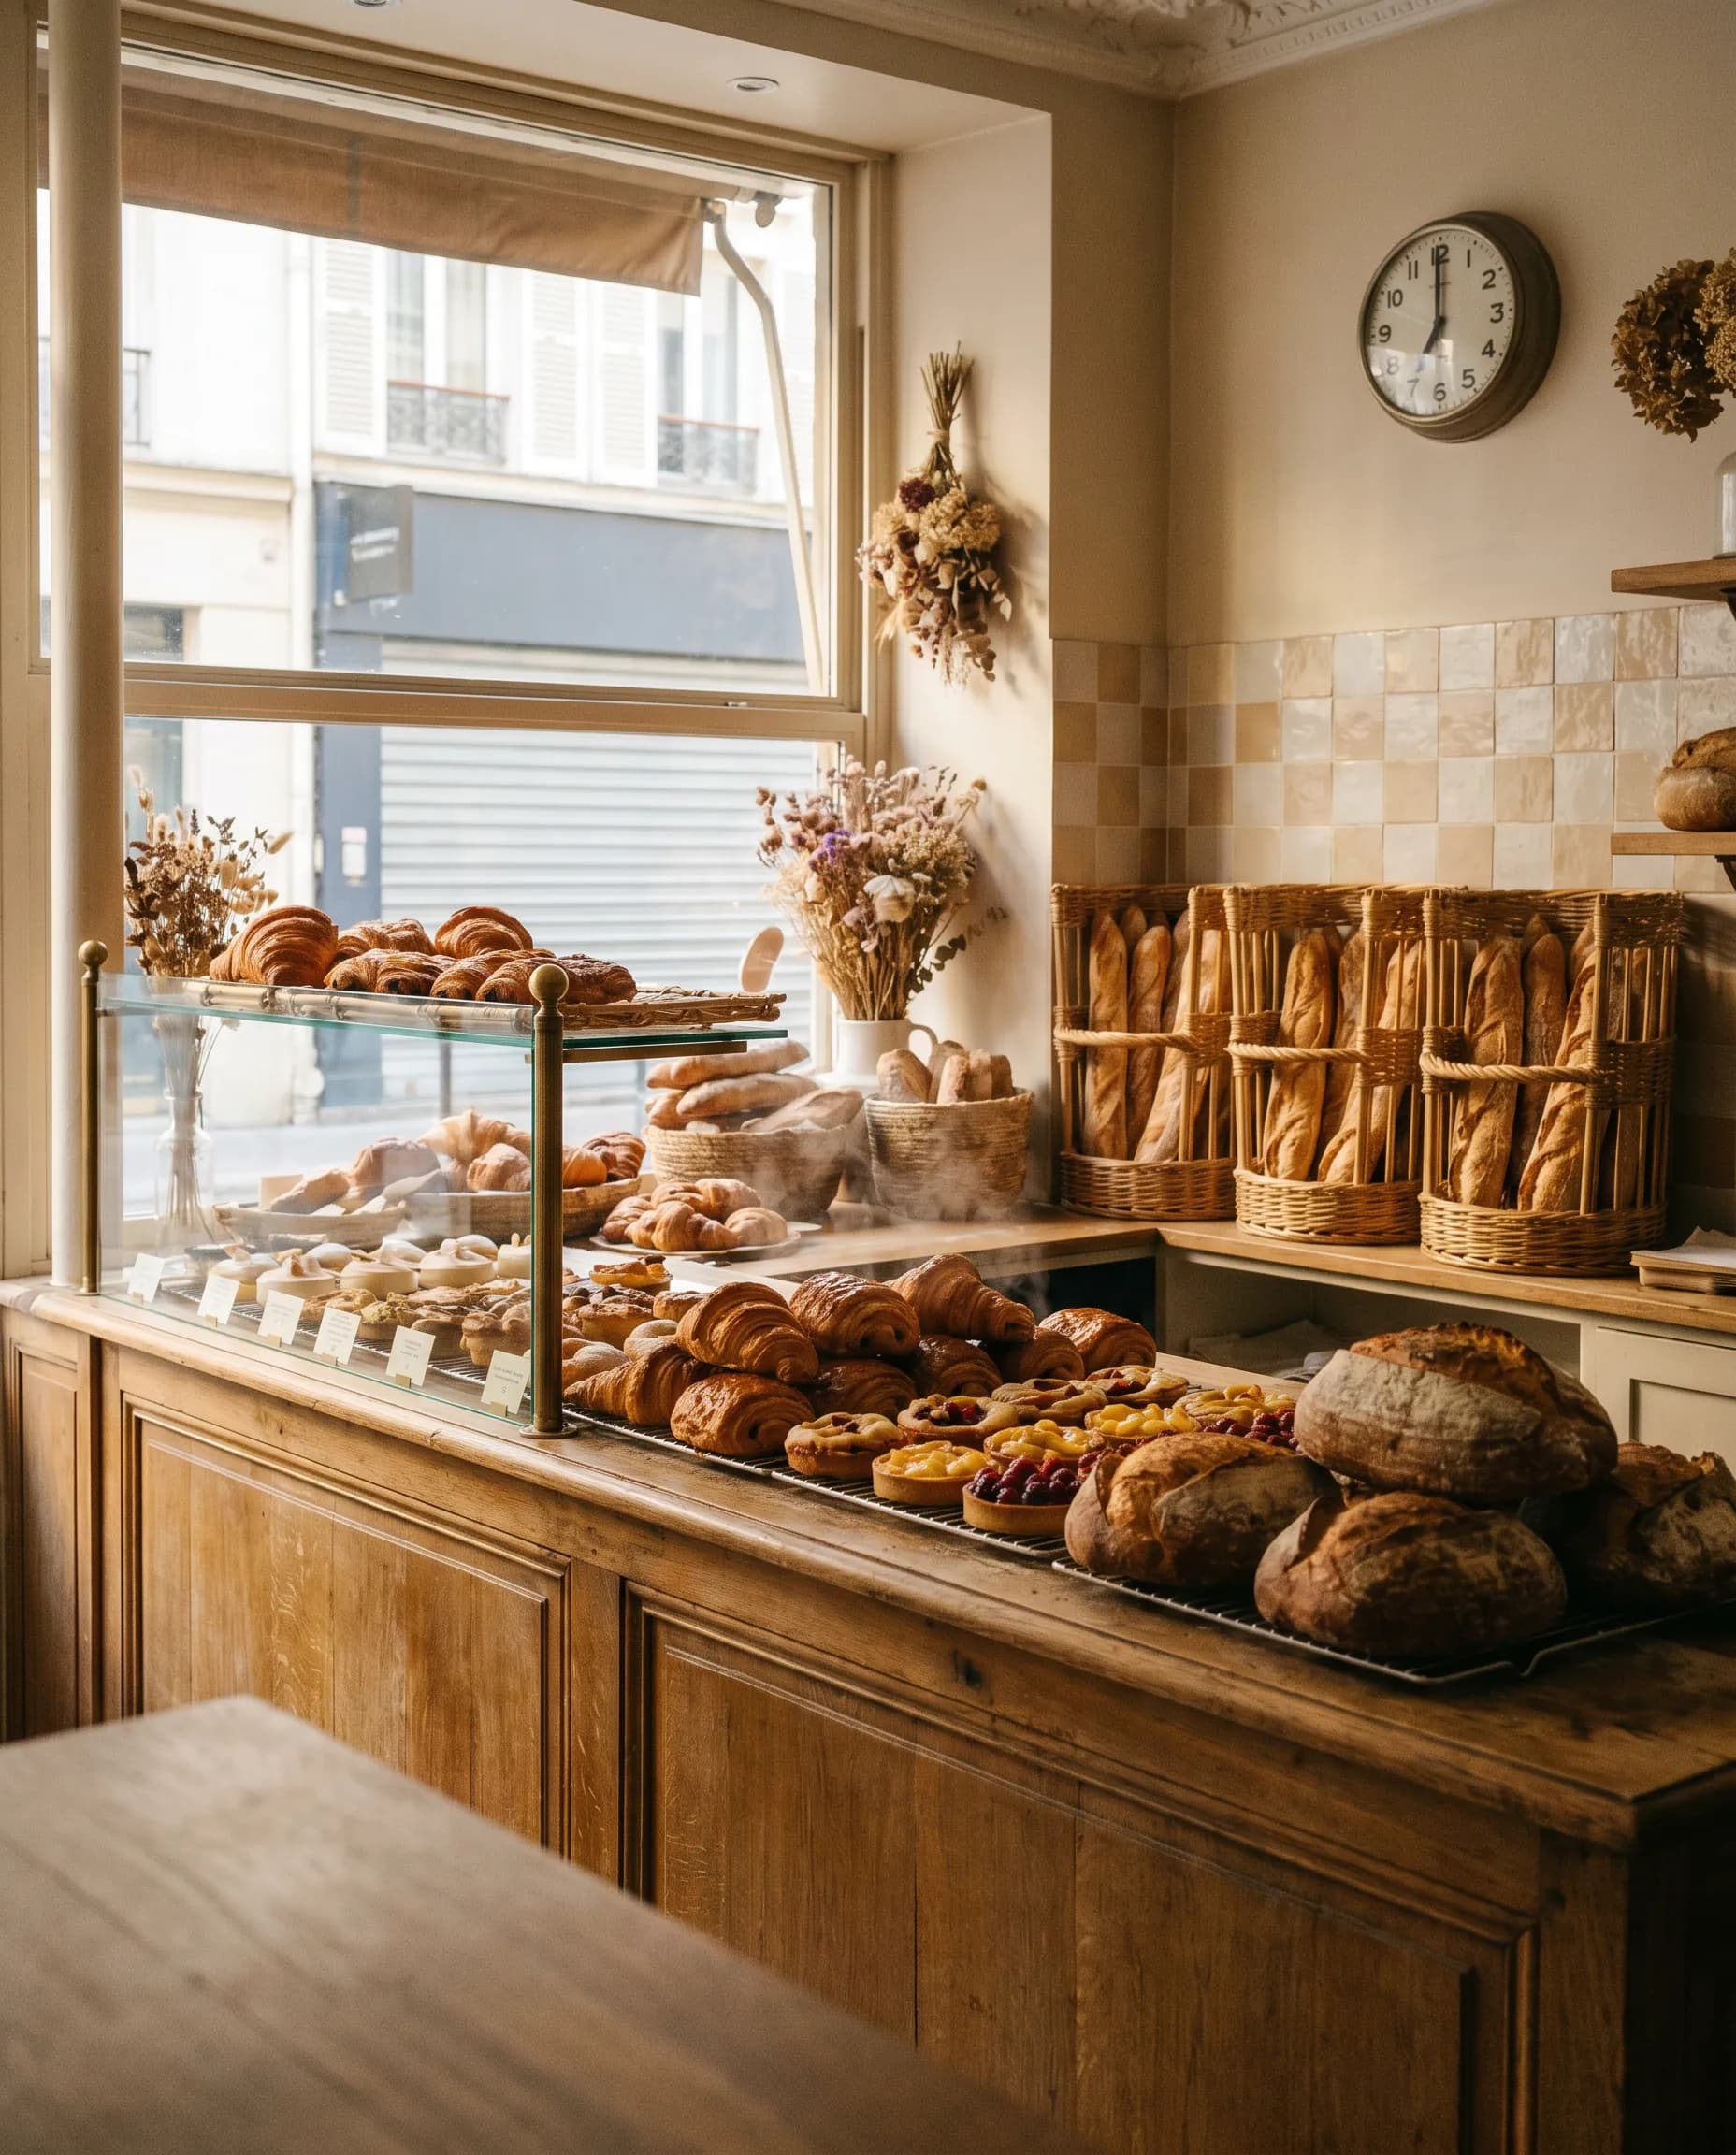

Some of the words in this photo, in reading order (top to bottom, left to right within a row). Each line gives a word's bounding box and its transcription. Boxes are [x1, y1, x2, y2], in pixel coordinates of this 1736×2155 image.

[1431, 244, 1450, 267] 12
[1467, 249, 1471, 268] 1
[1408, 260, 1418, 280] 11
[1482, 269, 1497, 290] 2
[1387, 289, 1403, 309] 10
[1490, 302, 1504, 324] 3
[1378, 325, 1392, 343] 9
[1481, 339, 1496, 358] 4
[1387, 356, 1399, 375] 8
[1407, 378, 1420, 398] 7
[1462, 369, 1476, 389] 5
[1433, 383, 1447, 402] 6
